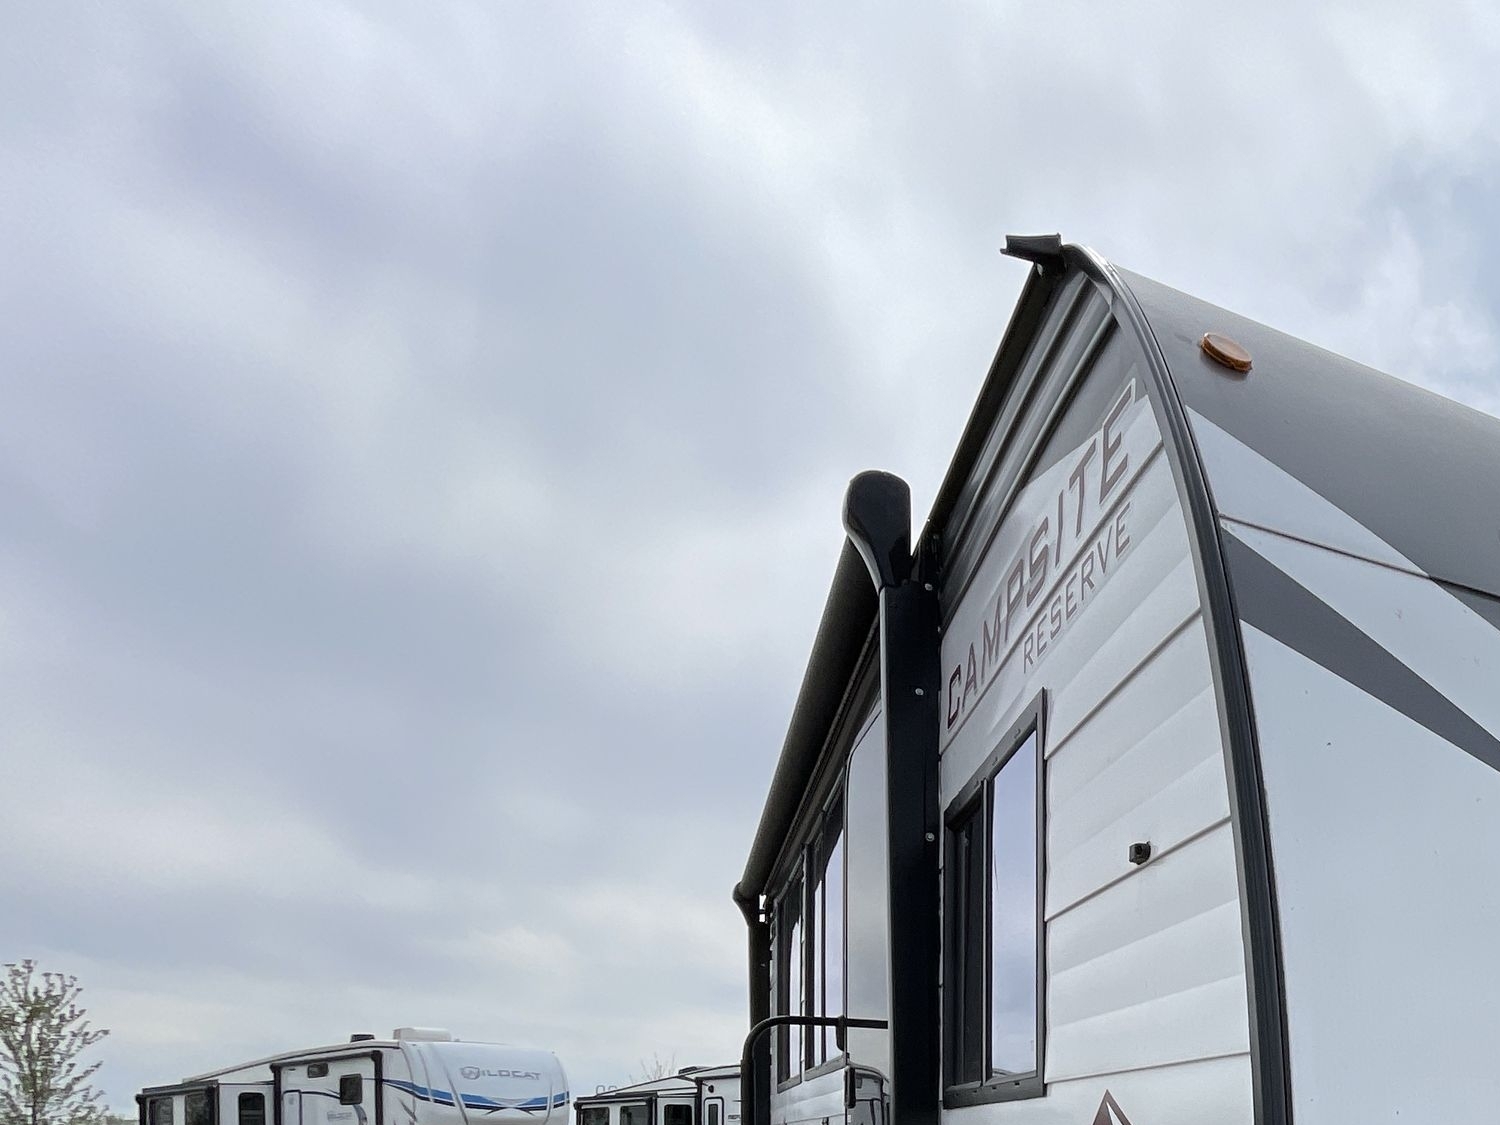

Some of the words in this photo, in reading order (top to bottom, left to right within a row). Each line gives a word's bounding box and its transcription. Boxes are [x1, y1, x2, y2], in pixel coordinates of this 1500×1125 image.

[947, 380, 1134, 730] CAMPSITE
[1022, 500, 1132, 674] RESERVE
[460, 1066, 541, 1080] WILDCAT
